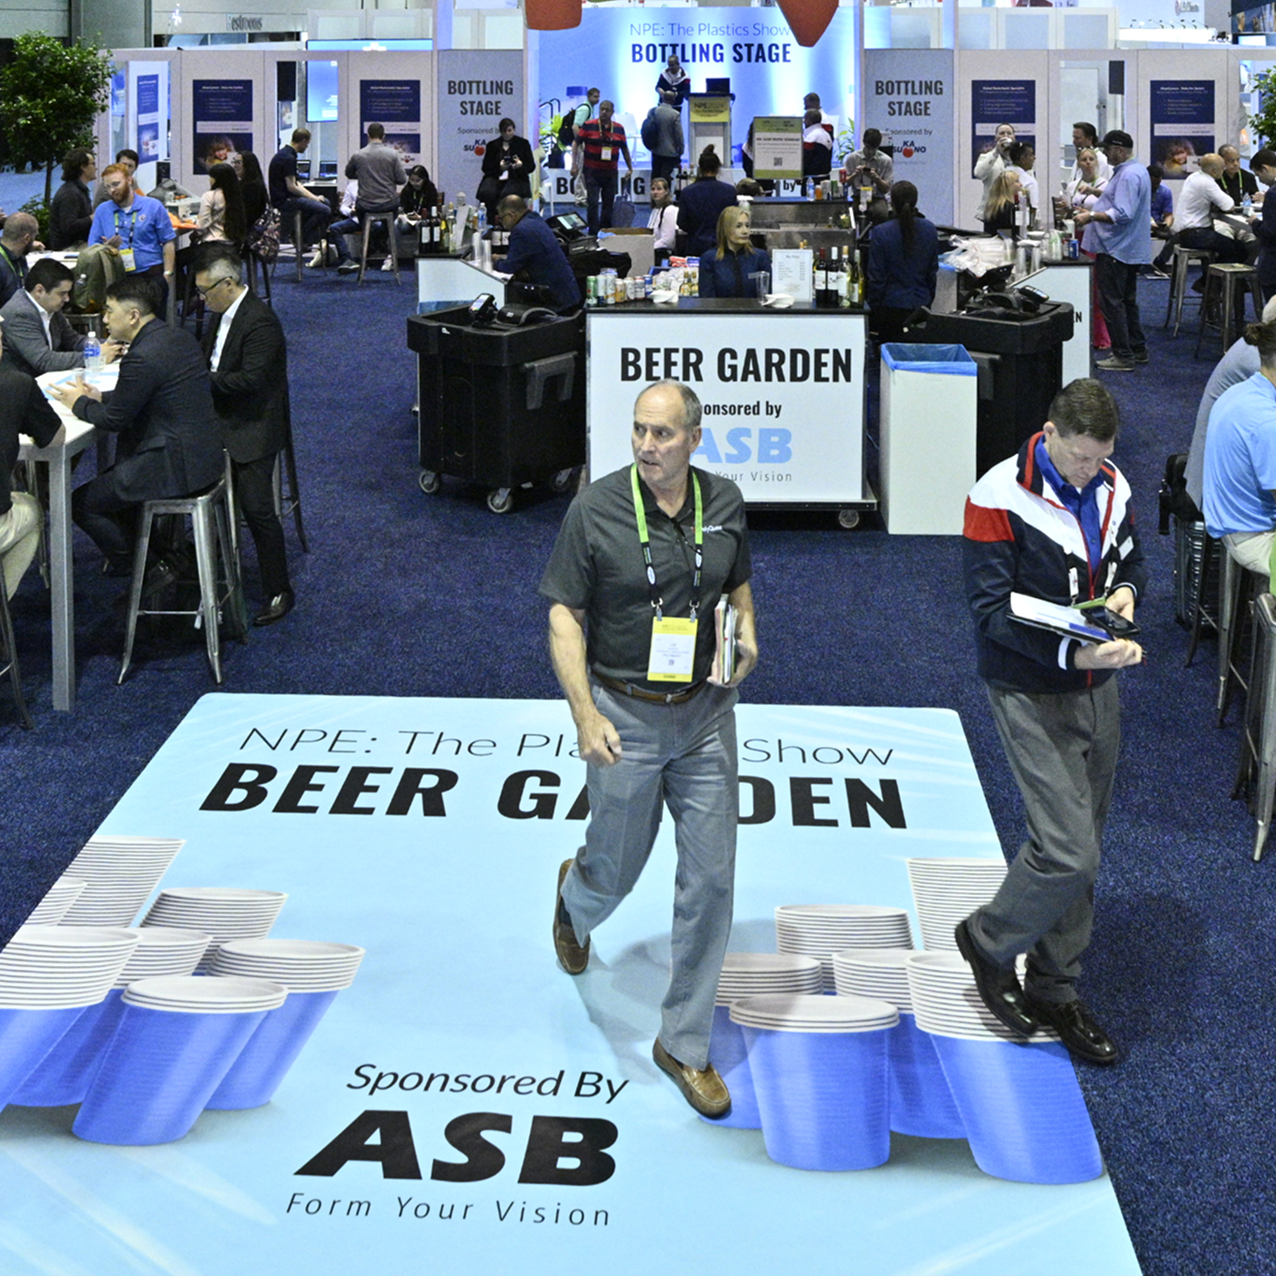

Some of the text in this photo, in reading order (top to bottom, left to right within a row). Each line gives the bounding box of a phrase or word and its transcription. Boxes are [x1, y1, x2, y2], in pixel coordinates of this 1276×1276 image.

[630, 22, 791, 37] NPE: The Plastics Show
[631, 42, 792, 63] BOTTLING STAGE
[447, 80, 514, 95] BOTTLING
[875, 80, 943, 96] BOTTLING
[459, 100, 502, 116] STAGE
[887, 101, 931, 116] STAGE
[457, 127, 493, 136] Sponsored
[923, 128, 933, 136] by
[620, 347, 852, 383] BEER GARDEN
[702, 400, 782, 419] onsored by
[689, 427, 793, 465] ASB
[750, 471, 793, 482] Vision
[239, 727, 378, 754] NPE:
[398, 729, 497, 757] The
[742, 738, 894, 766] Show
[198, 762, 459, 817] BEER
[346, 1063, 630, 1104] Sponsored By
[292, 1109, 619, 1187] ASB
[286, 1192, 610, 1226] Form Your Vision
